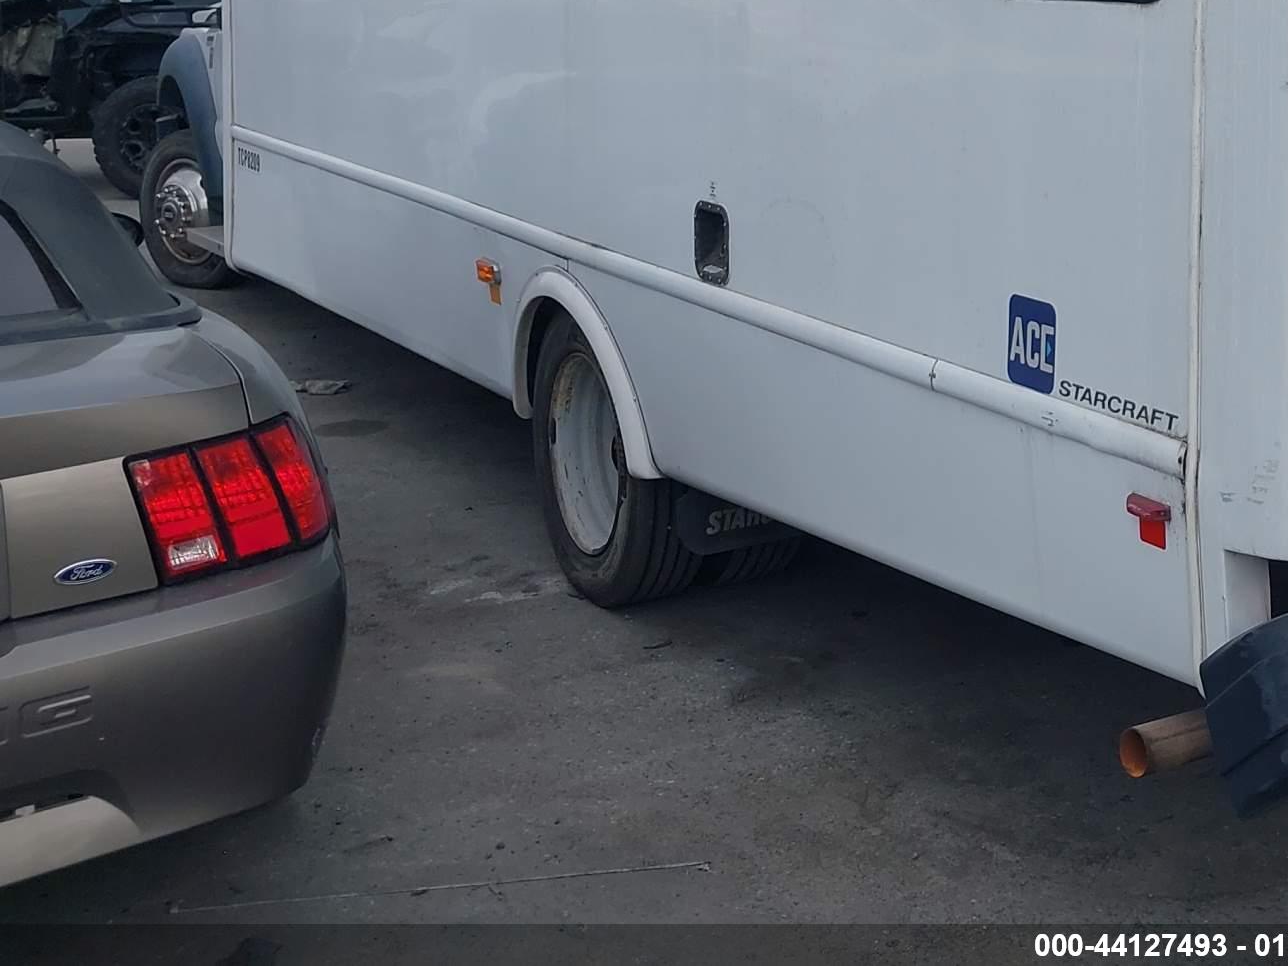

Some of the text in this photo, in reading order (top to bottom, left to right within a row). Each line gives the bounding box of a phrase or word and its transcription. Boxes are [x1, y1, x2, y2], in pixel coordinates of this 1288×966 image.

[1010, 316, 1055, 374] ACE
[1058, 380, 1179, 431] STARCRAFT
[69, 563, 104, 581] Ford
